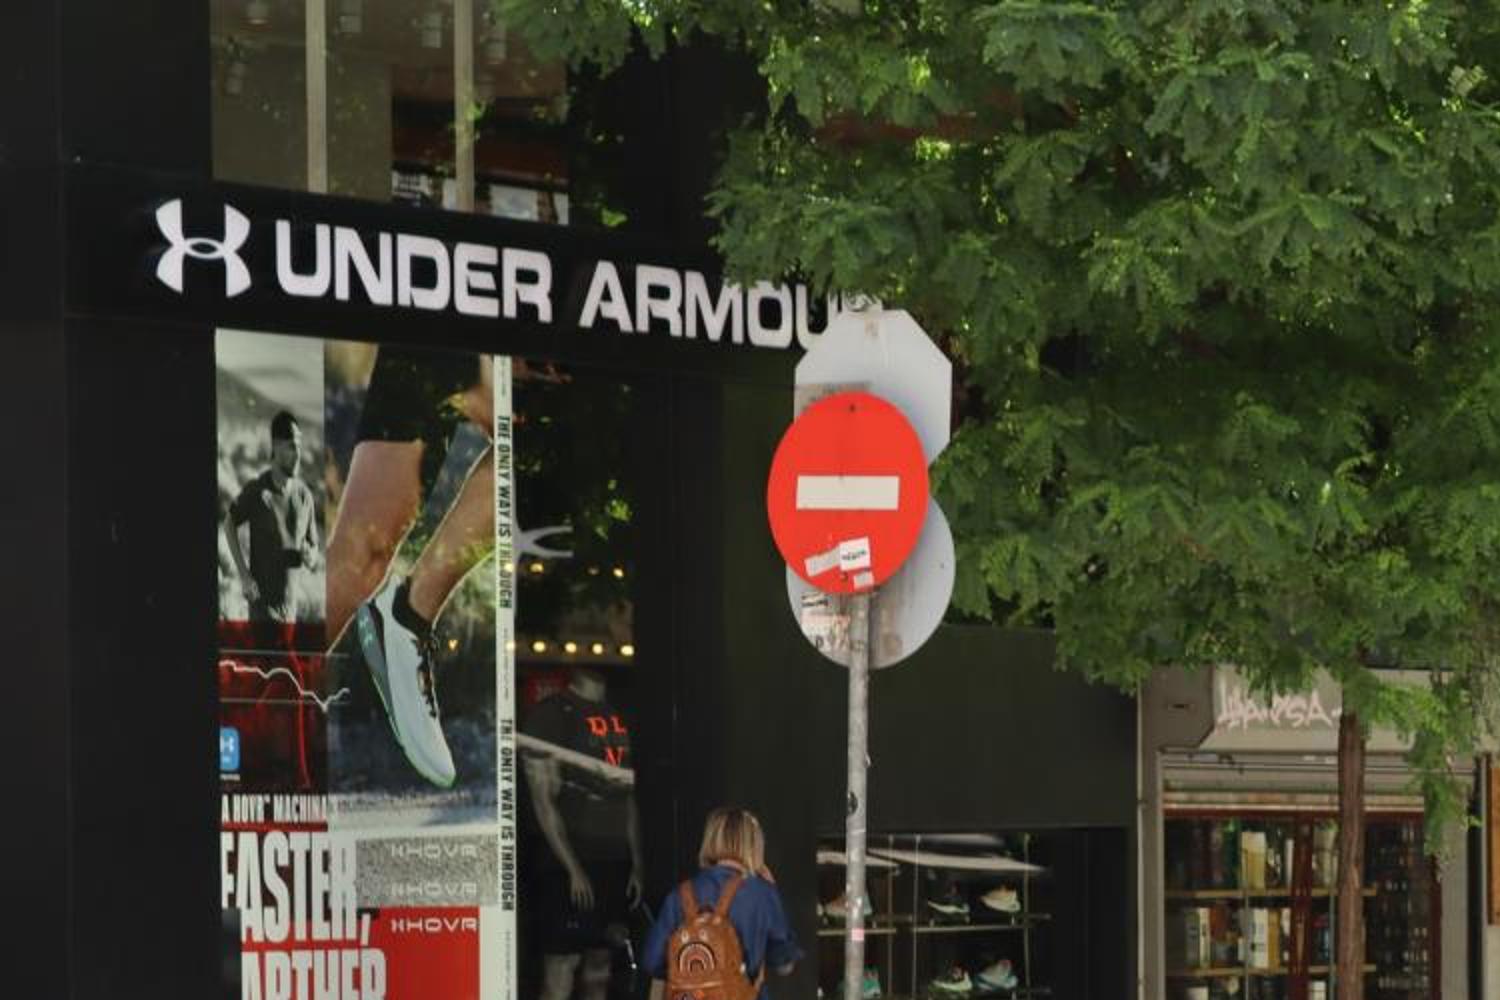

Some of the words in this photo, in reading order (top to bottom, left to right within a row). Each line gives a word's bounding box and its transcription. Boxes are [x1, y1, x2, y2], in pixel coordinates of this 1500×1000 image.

[275, 219, 552, 323] UNDER
[578, 260, 882, 350] ARMOU
[498, 415, 511, 439] THE
[499, 444, 511, 480] ONLY
[499, 486, 512, 518] WAY
[499, 523, 511, 537] IS
[501, 747, 514, 783] ONLY
[221, 794, 230, 823] A
[501, 788, 514, 821] WAY
[502, 826, 514, 840] IS
[501, 845, 515, 911] THROUGH
